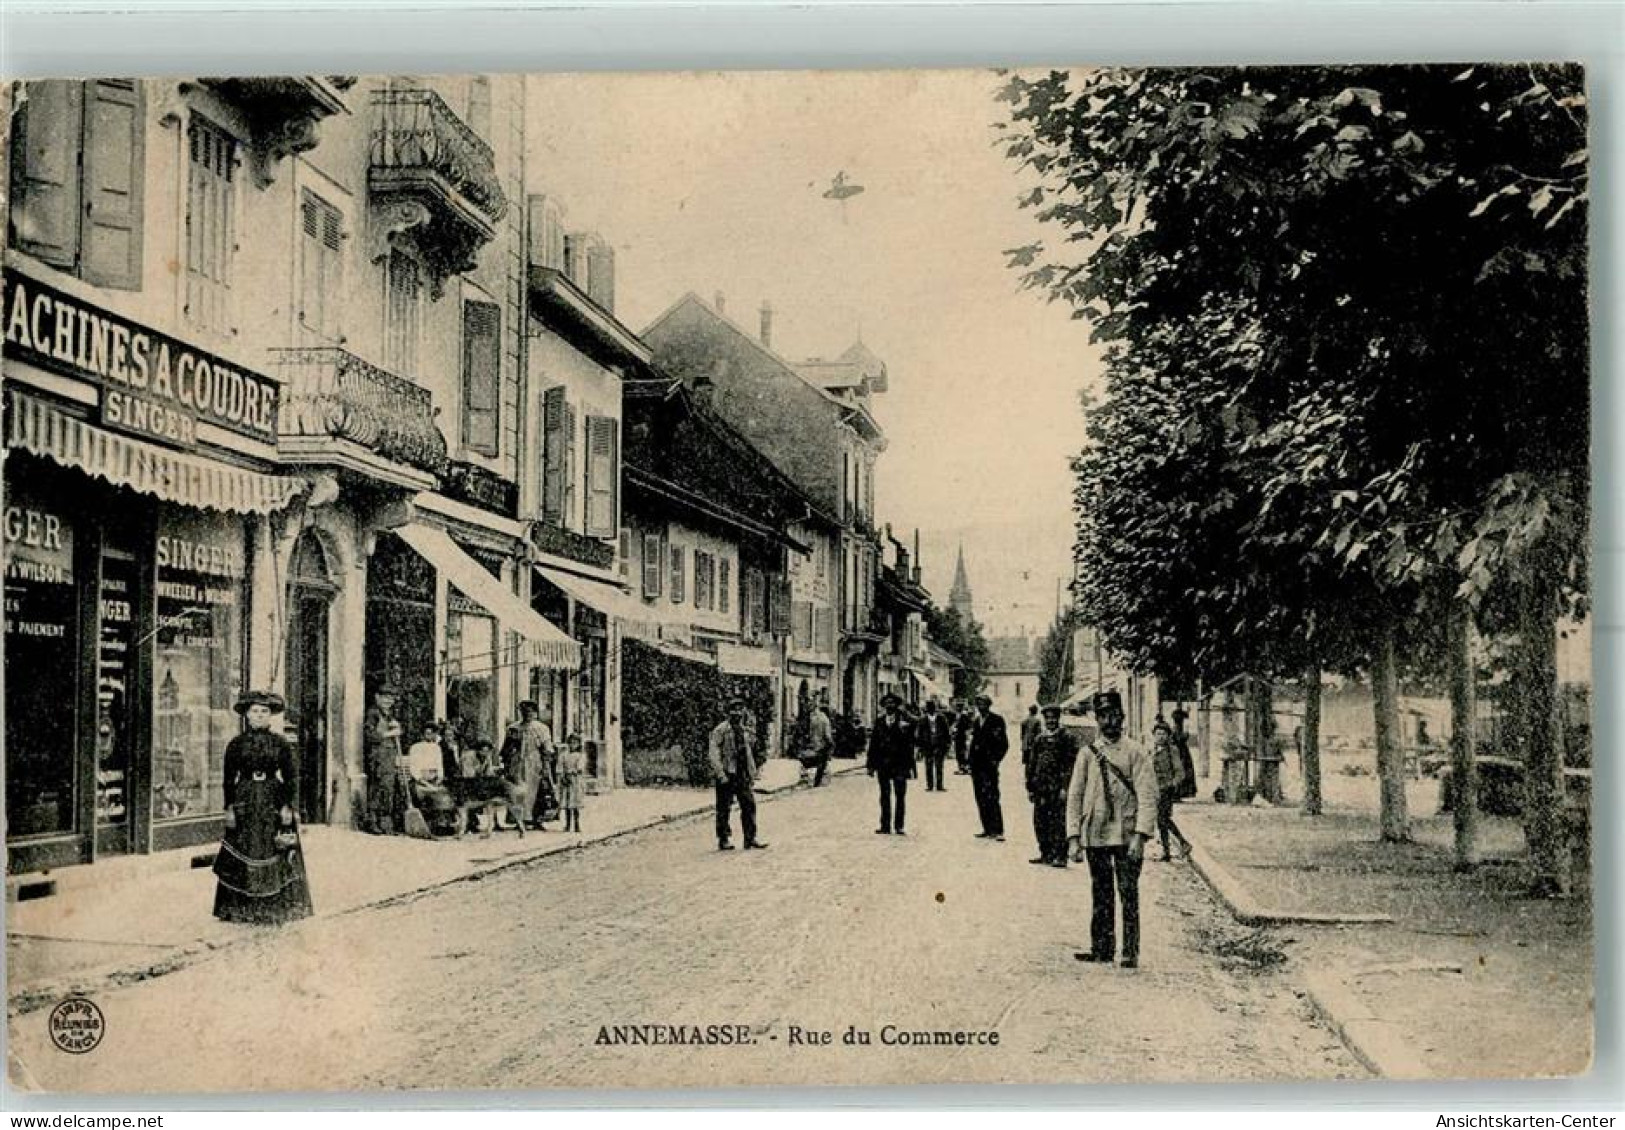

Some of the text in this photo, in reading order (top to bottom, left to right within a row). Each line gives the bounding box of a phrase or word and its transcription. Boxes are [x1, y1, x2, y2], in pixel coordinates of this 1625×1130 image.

[4, 280, 151, 388] ACHINES
[178, 352, 276, 433] COUDRE
[106, 391, 196, 445] SINGER
[157, 536, 235, 577] SINGER
